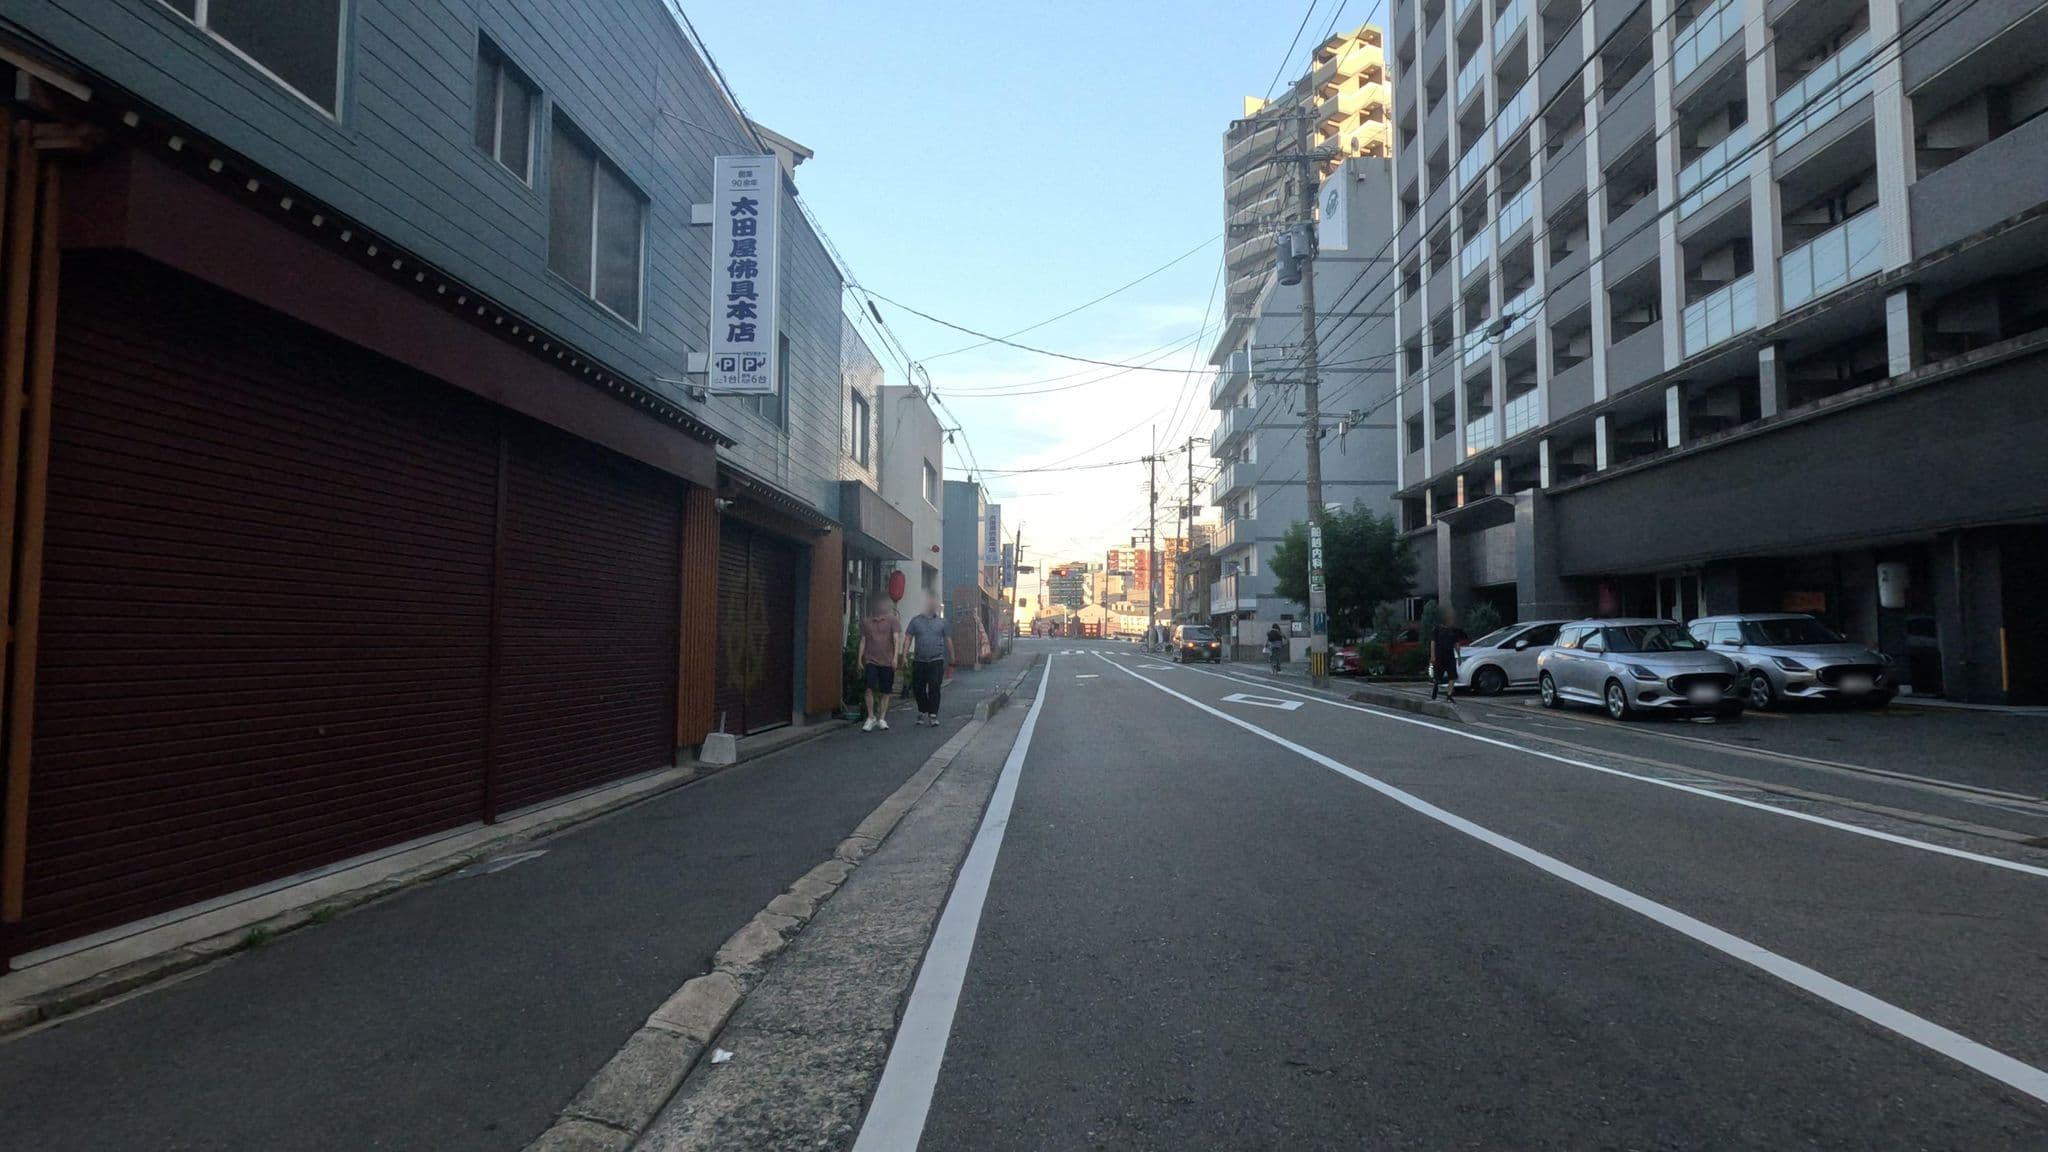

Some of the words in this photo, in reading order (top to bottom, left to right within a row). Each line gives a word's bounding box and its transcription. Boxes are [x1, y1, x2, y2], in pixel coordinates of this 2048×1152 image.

[726, 196, 759, 343] 太田屋佛具本店
[722, 359, 734, 371] P
[744, 359, 756, 371] P
